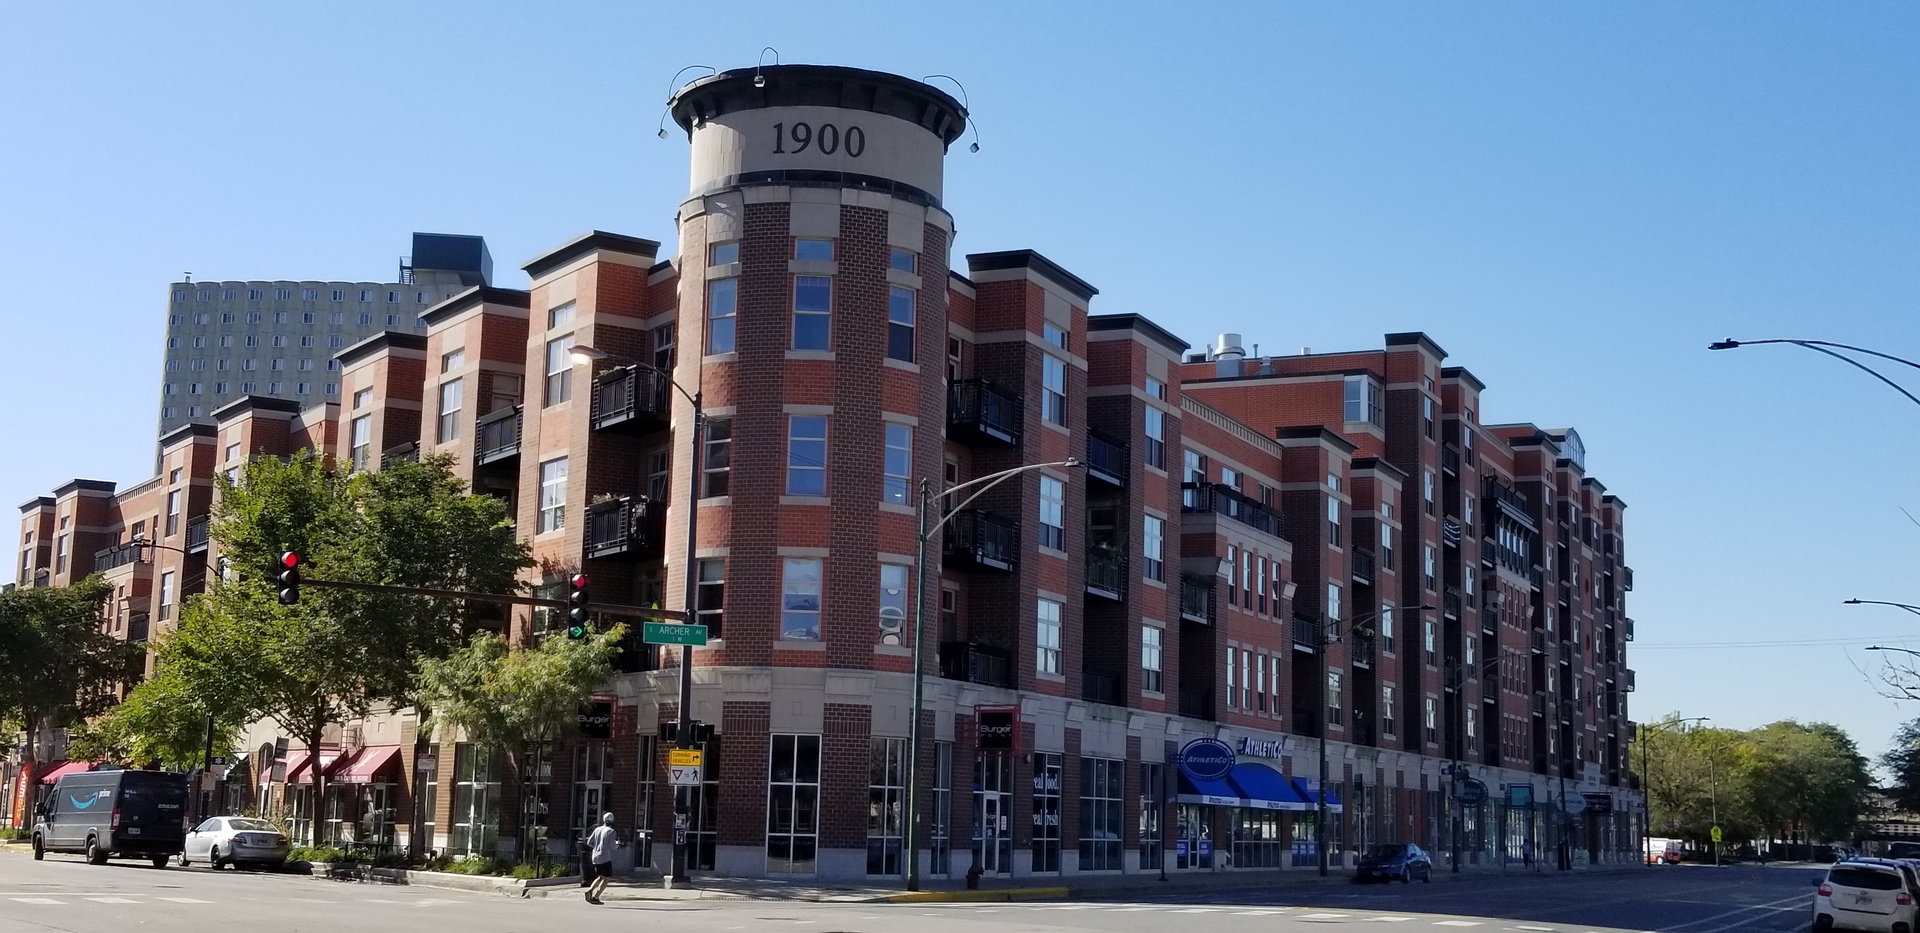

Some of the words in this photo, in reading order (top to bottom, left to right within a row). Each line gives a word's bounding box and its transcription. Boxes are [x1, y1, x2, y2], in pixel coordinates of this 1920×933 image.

[772, 121, 866, 158] 1900
[658, 625, 690, 636] ARCHER
[577, 714, 610, 725] Burger
[980, 724, 1012, 734] Burger
